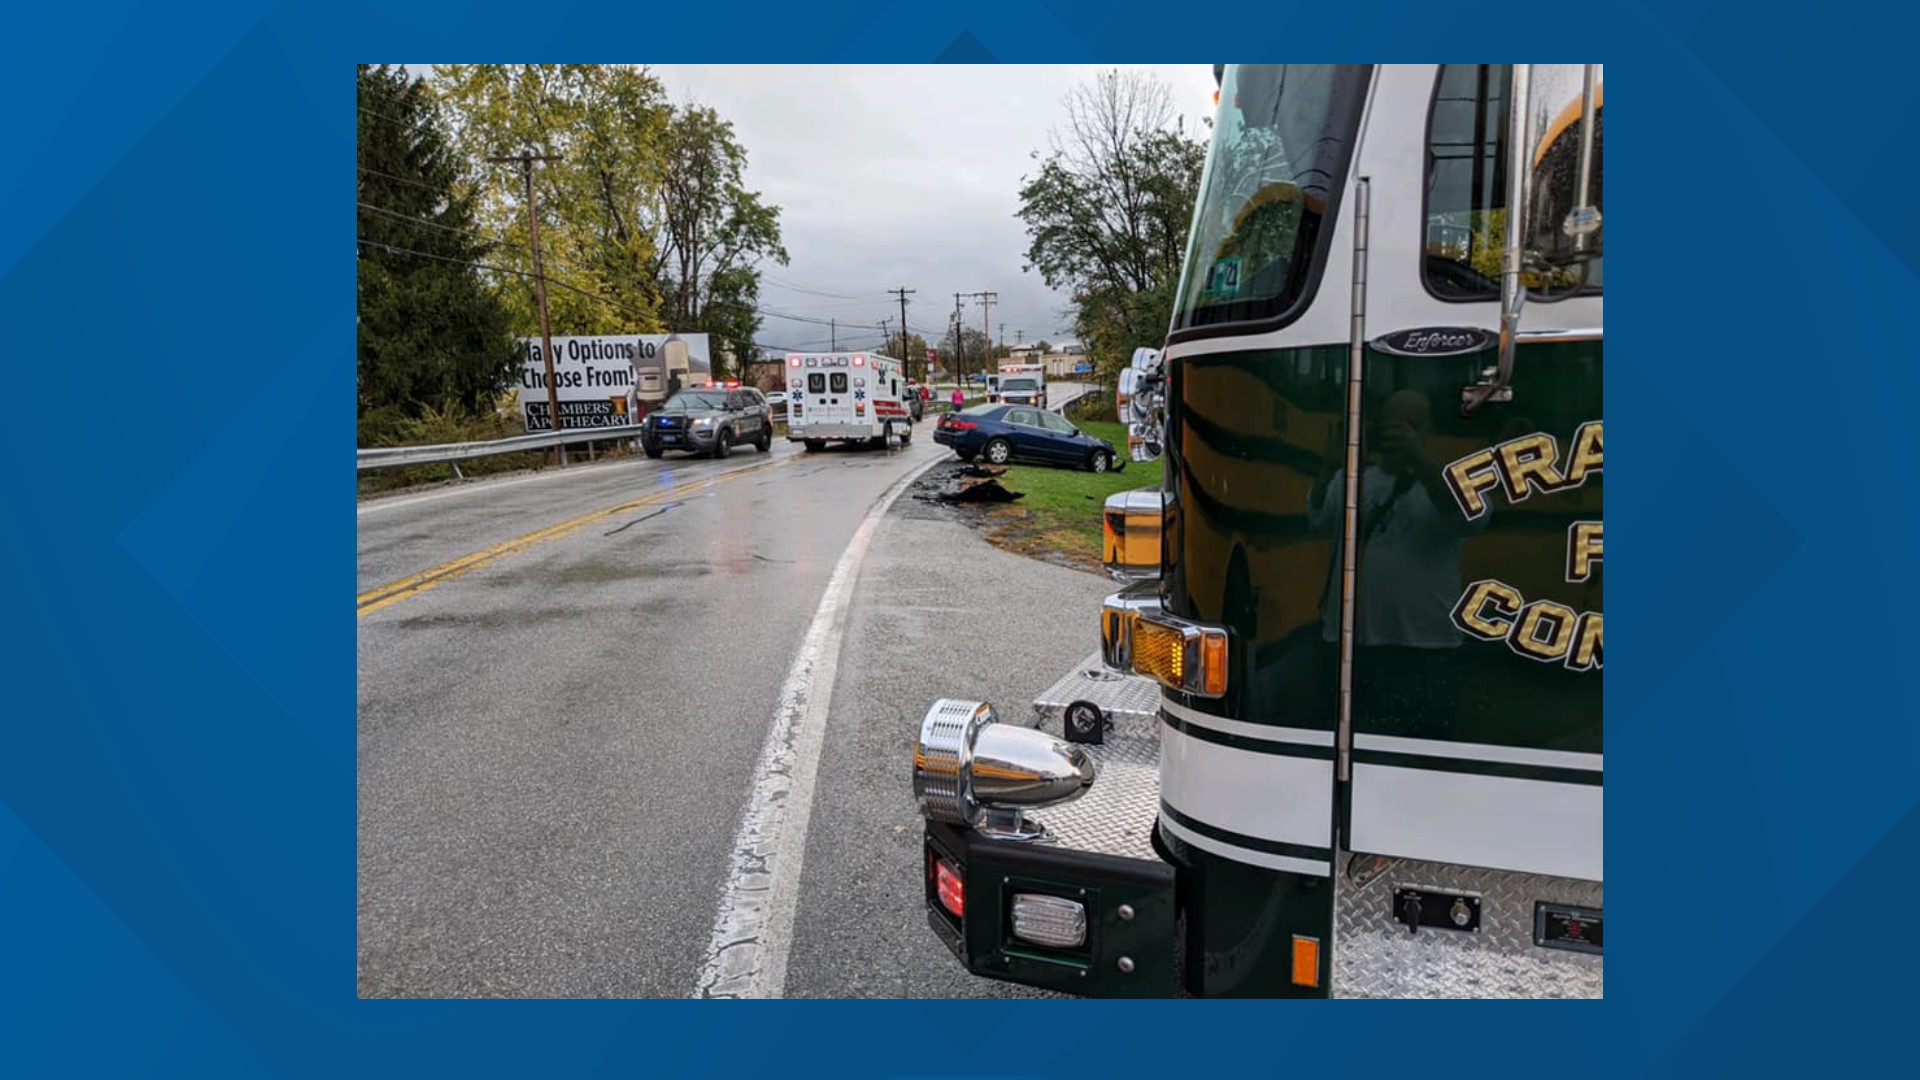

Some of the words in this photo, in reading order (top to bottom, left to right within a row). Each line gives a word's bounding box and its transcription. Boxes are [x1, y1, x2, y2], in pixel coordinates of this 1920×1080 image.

[525, 342, 563, 364] ay
[568, 339, 635, 363] Options
[638, 338, 656, 359] to
[1402, 331, 1476, 352] Enforcer
[586, 365, 635, 387] From!
[527, 401, 612, 416] CHMBERS'
[529, 415, 629, 429] APTHECARY
